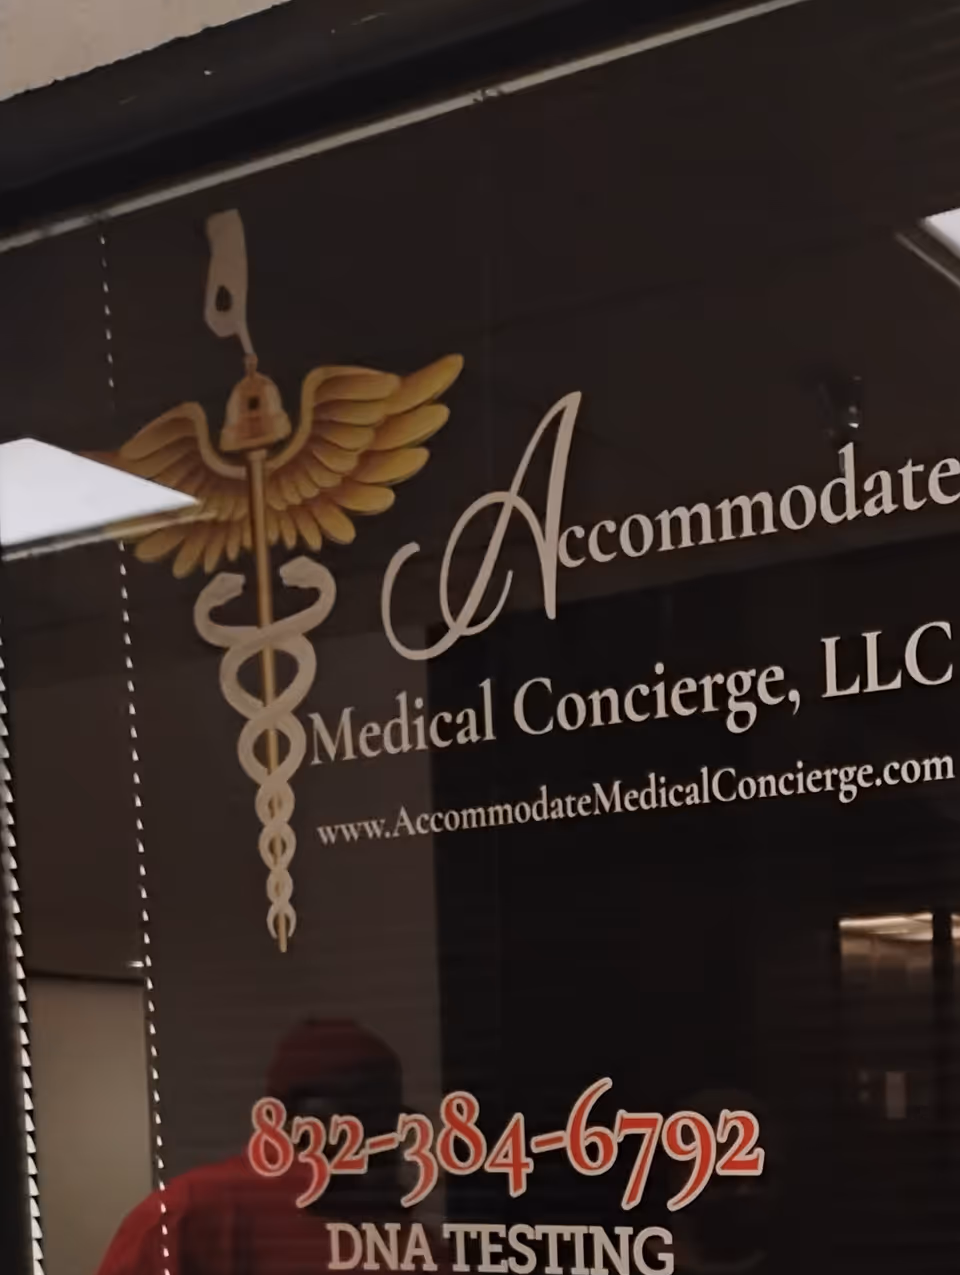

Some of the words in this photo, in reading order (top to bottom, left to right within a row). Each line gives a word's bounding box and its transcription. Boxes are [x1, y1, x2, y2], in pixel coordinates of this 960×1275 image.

[308, 680, 497, 765] Medical
[513, 662, 801, 734] Concierge,
[820, 621, 955, 698] LLC
[316, 754, 955, 846] www.AccommodateMedicalConcierge.com
[248, 1077, 764, 1211] 832-384-6792
[327, 1222, 435, 1271] DNA
